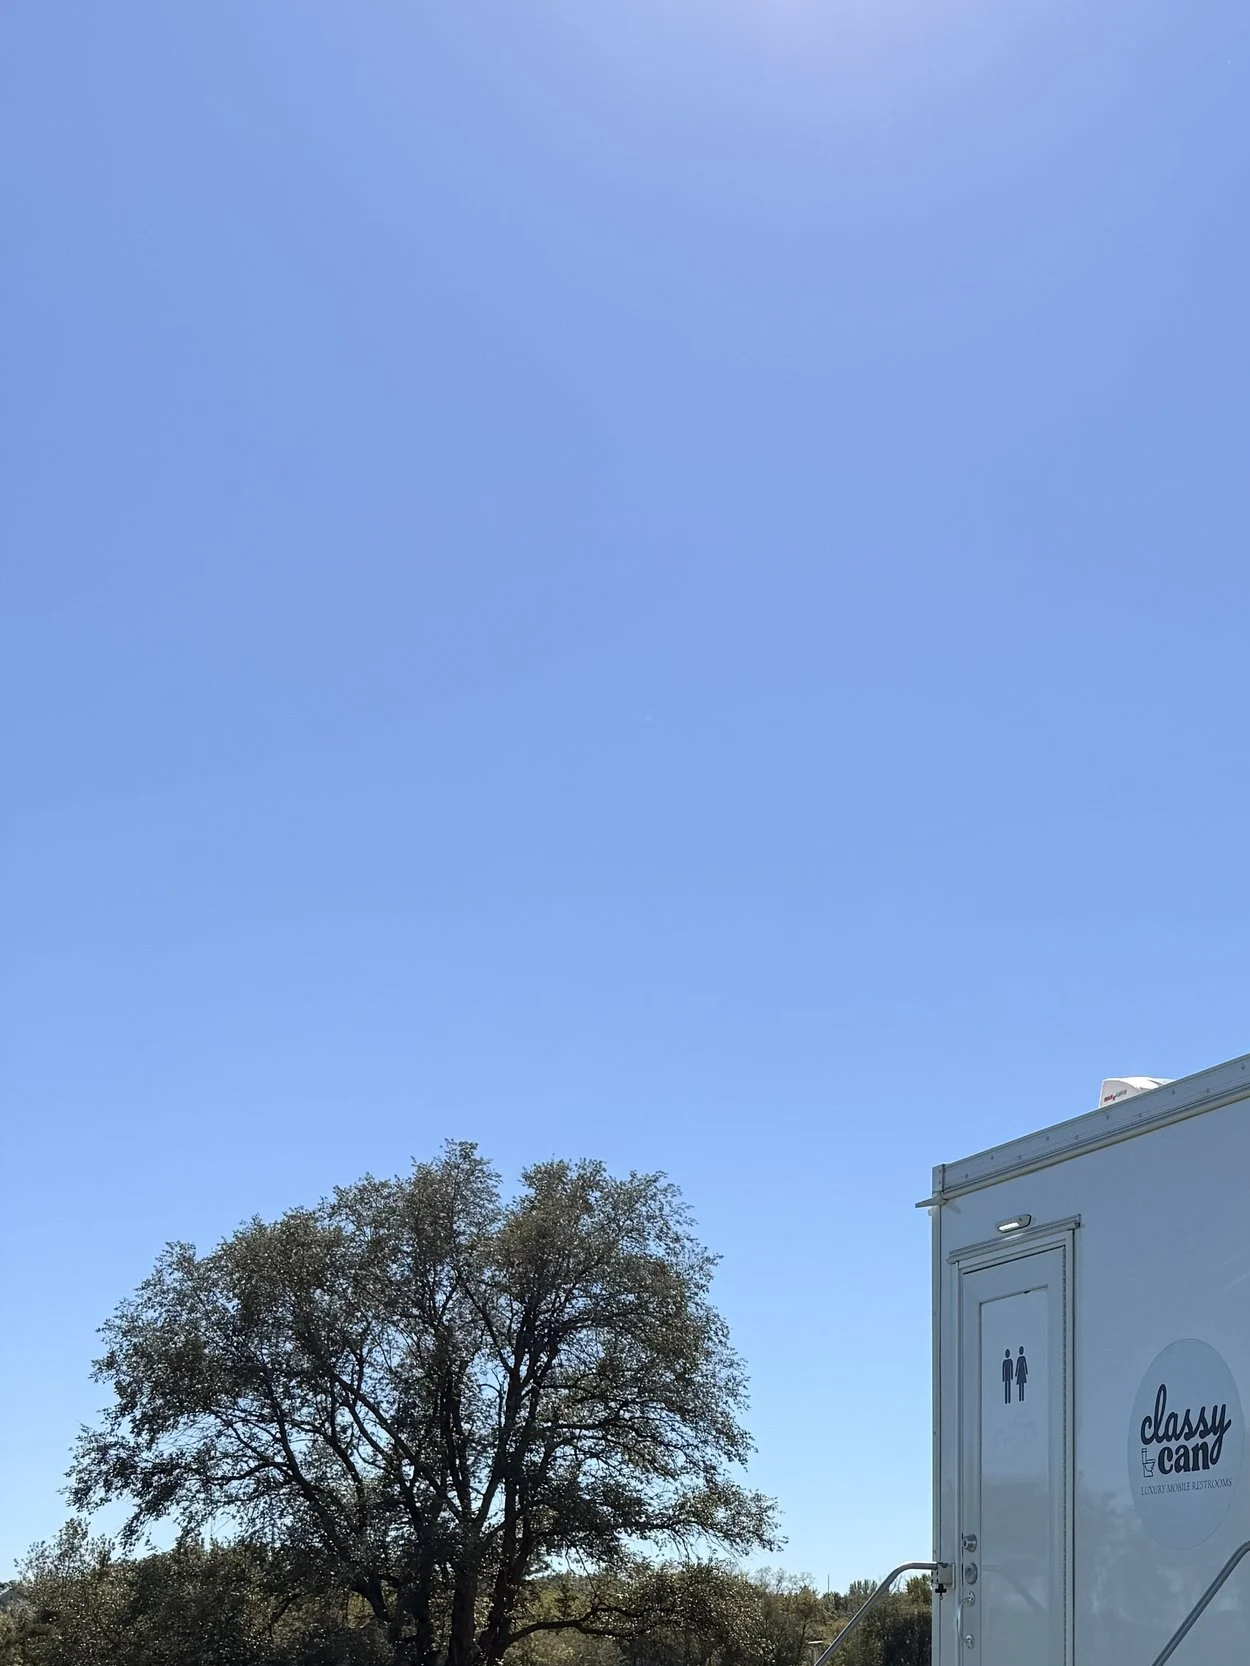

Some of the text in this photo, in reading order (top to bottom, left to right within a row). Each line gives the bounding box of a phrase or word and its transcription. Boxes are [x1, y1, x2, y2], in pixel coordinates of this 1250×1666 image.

[1140, 1383, 1232, 1465] classy
[1157, 1441, 1211, 1475] can
[1141, 1478, 1233, 1496] LUXURY MOBILE RESTROOMS
